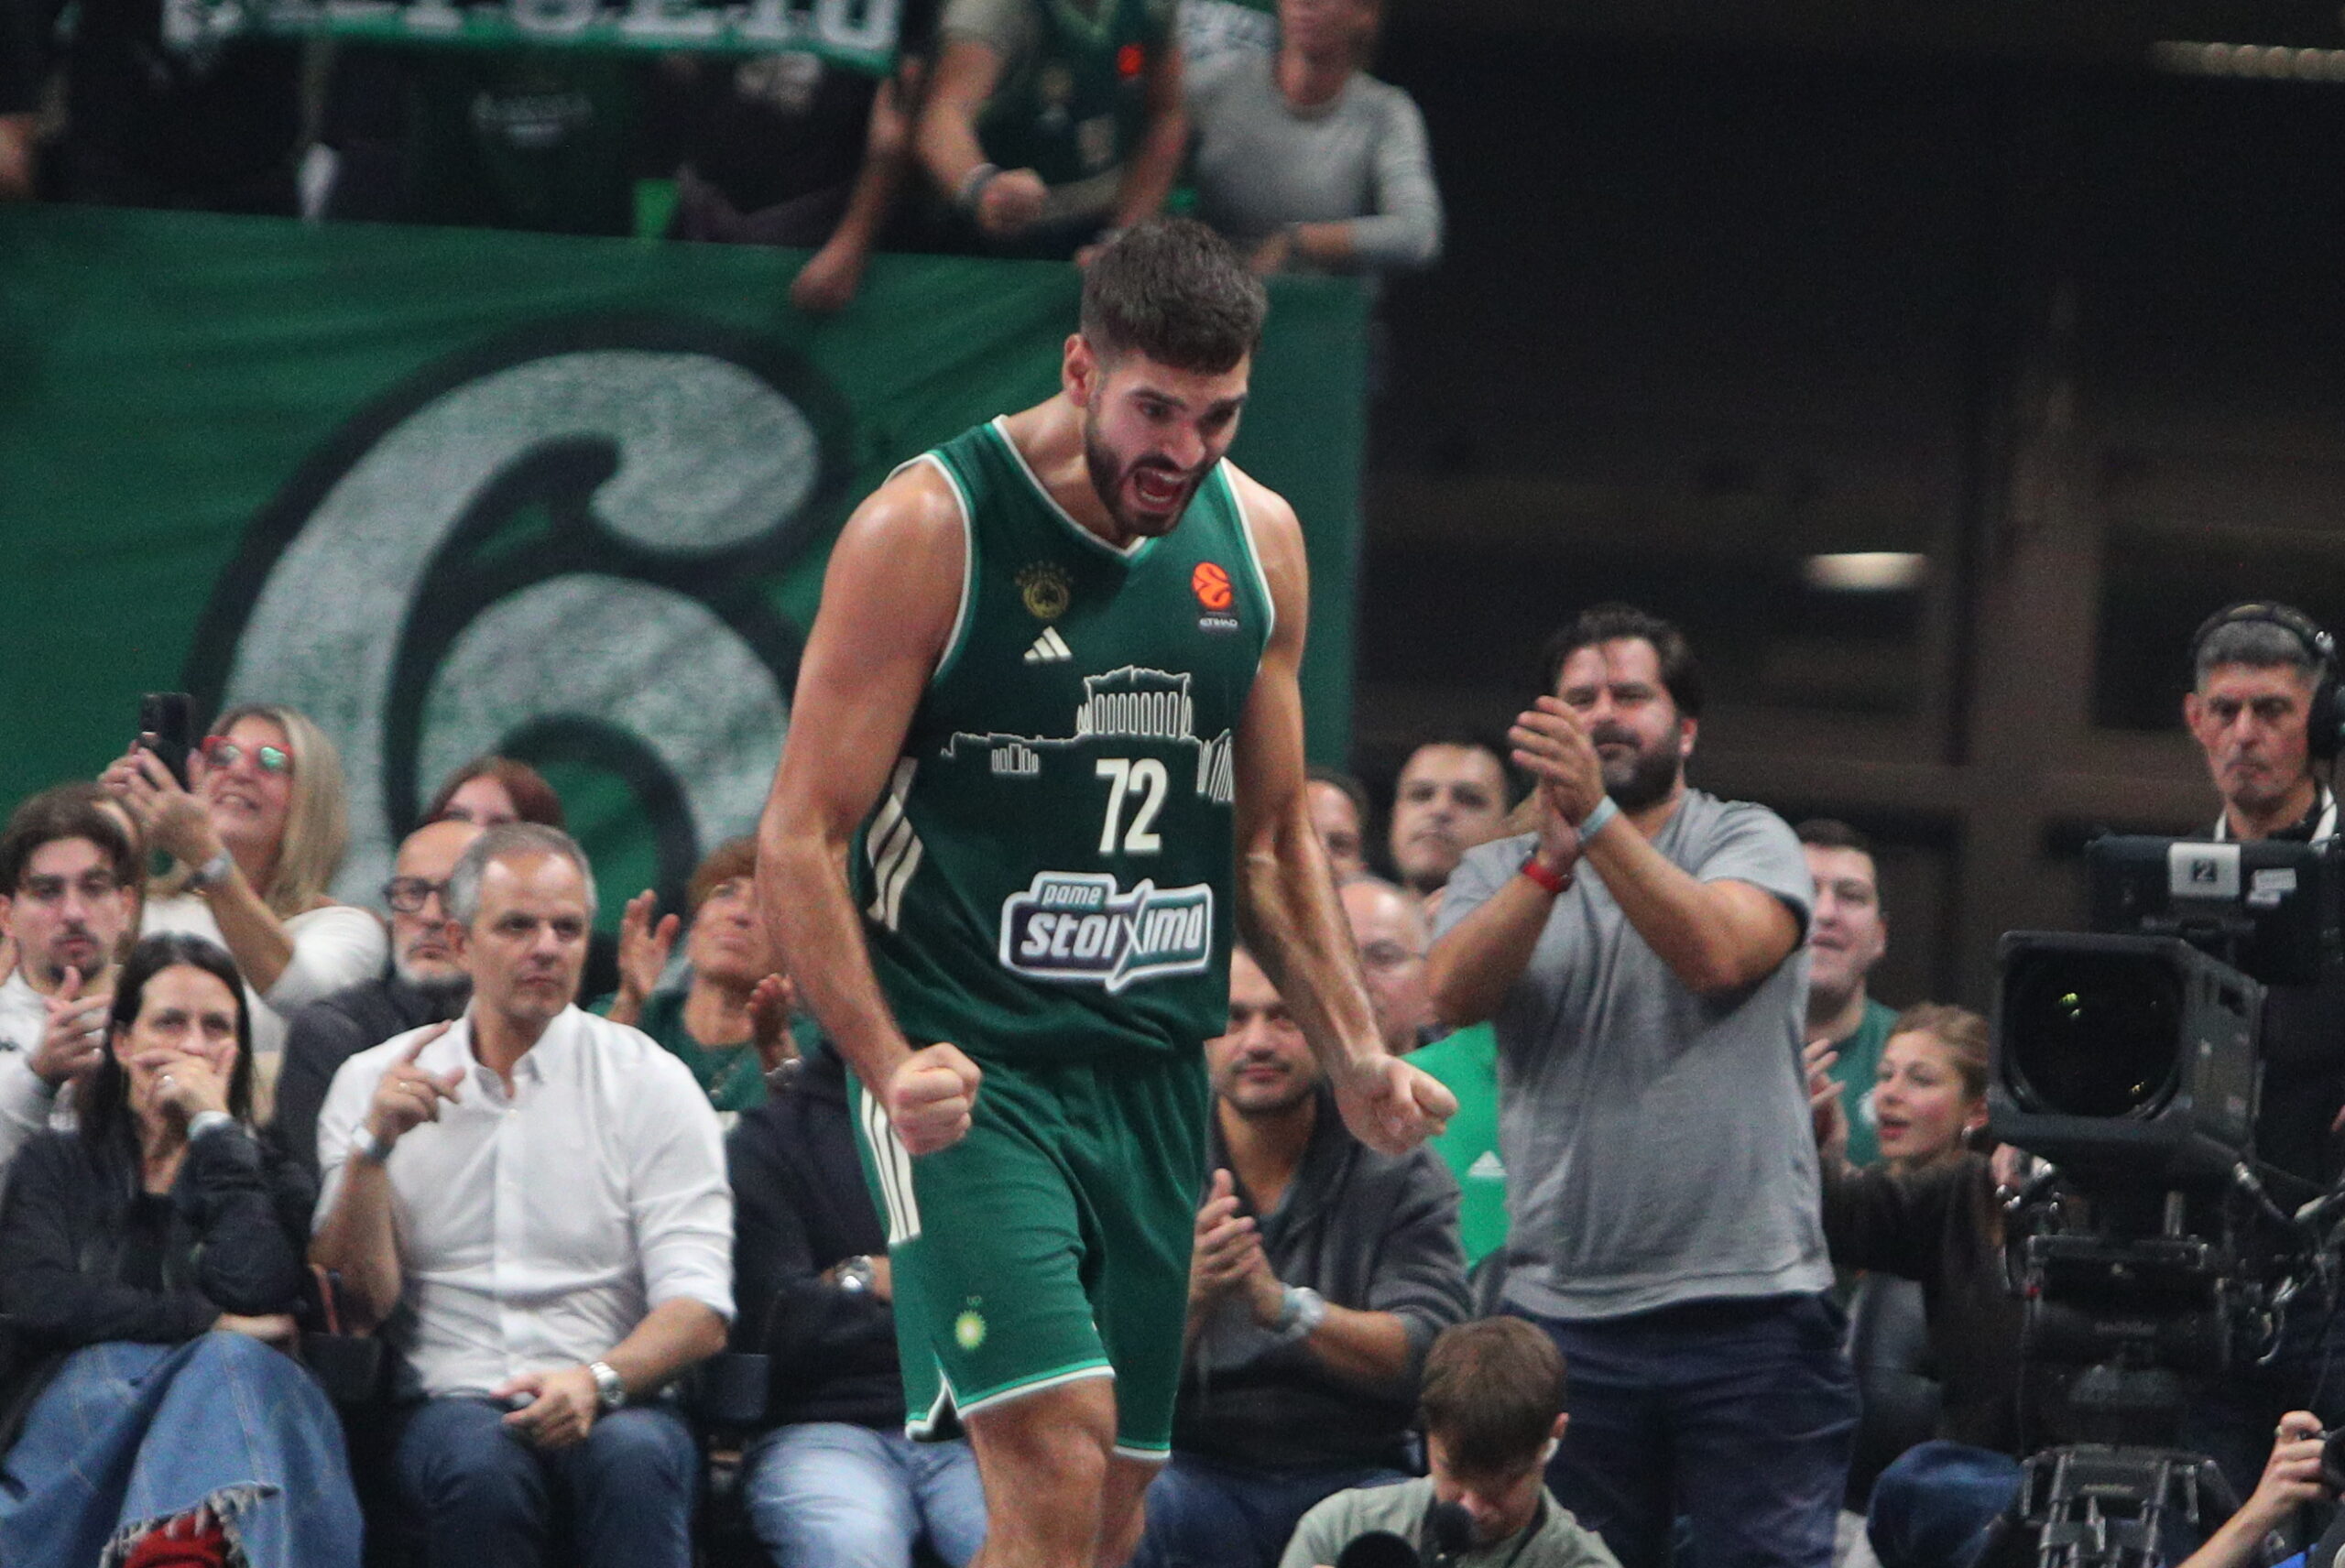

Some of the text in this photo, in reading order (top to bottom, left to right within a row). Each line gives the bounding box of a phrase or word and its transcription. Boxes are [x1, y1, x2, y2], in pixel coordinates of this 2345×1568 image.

[1199, 616, 1238, 628] ETIHAD
[1095, 758, 1169, 855] 72
[1041, 883, 1103, 907] pame
